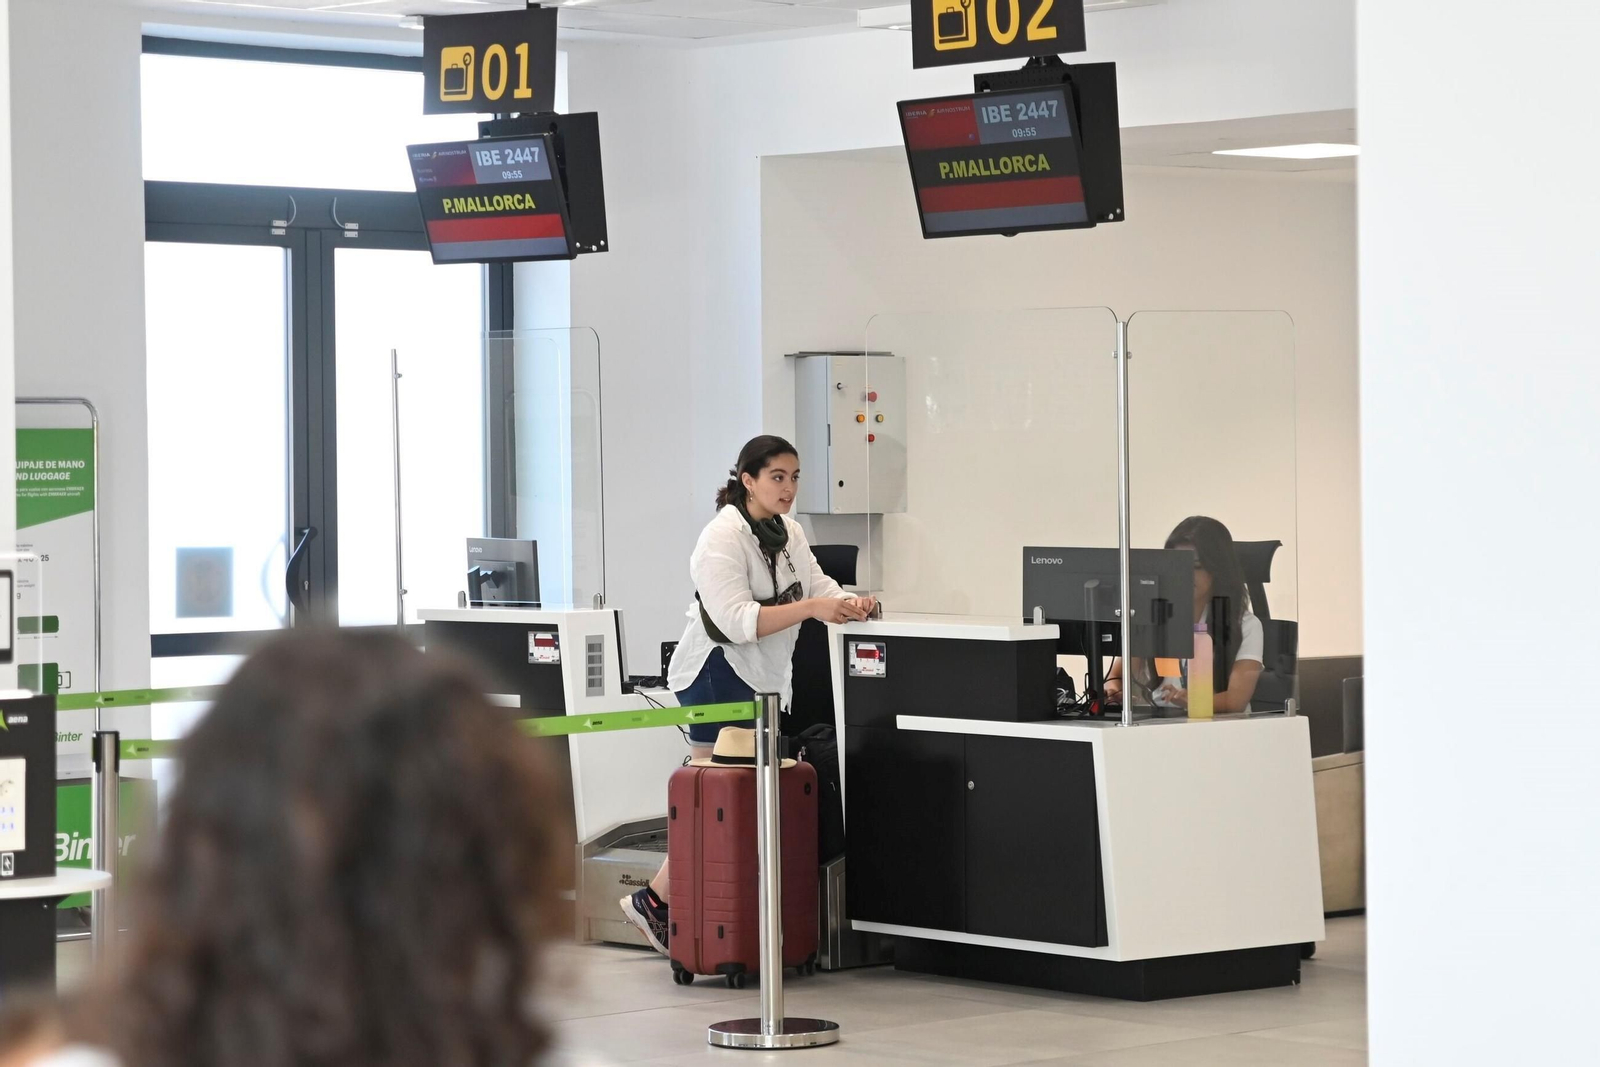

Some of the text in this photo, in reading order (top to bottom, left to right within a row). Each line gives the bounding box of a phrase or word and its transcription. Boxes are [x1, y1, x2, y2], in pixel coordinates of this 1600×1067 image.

[987, 0, 1057, 45] 02
[482, 43, 532, 100] 01
[981, 100, 1058, 124] IBE 2447
[1012, 127, 1037, 138] 09:55
[476, 147, 539, 166] IBE 2447
[939, 153, 1051, 179] P.MALLORCA
[502, 170, 523, 179] 09:55
[442, 193, 536, 214] P.MALLORCA
[45, 460, 57, 469] DE
[58, 460, 85, 469] MANO
[29, 472, 71, 481] LUGGAGE
[40, 554, 50, 562] 25
[1031, 556, 1063, 565] Lenovo
[7, 714, 28, 724] aena
